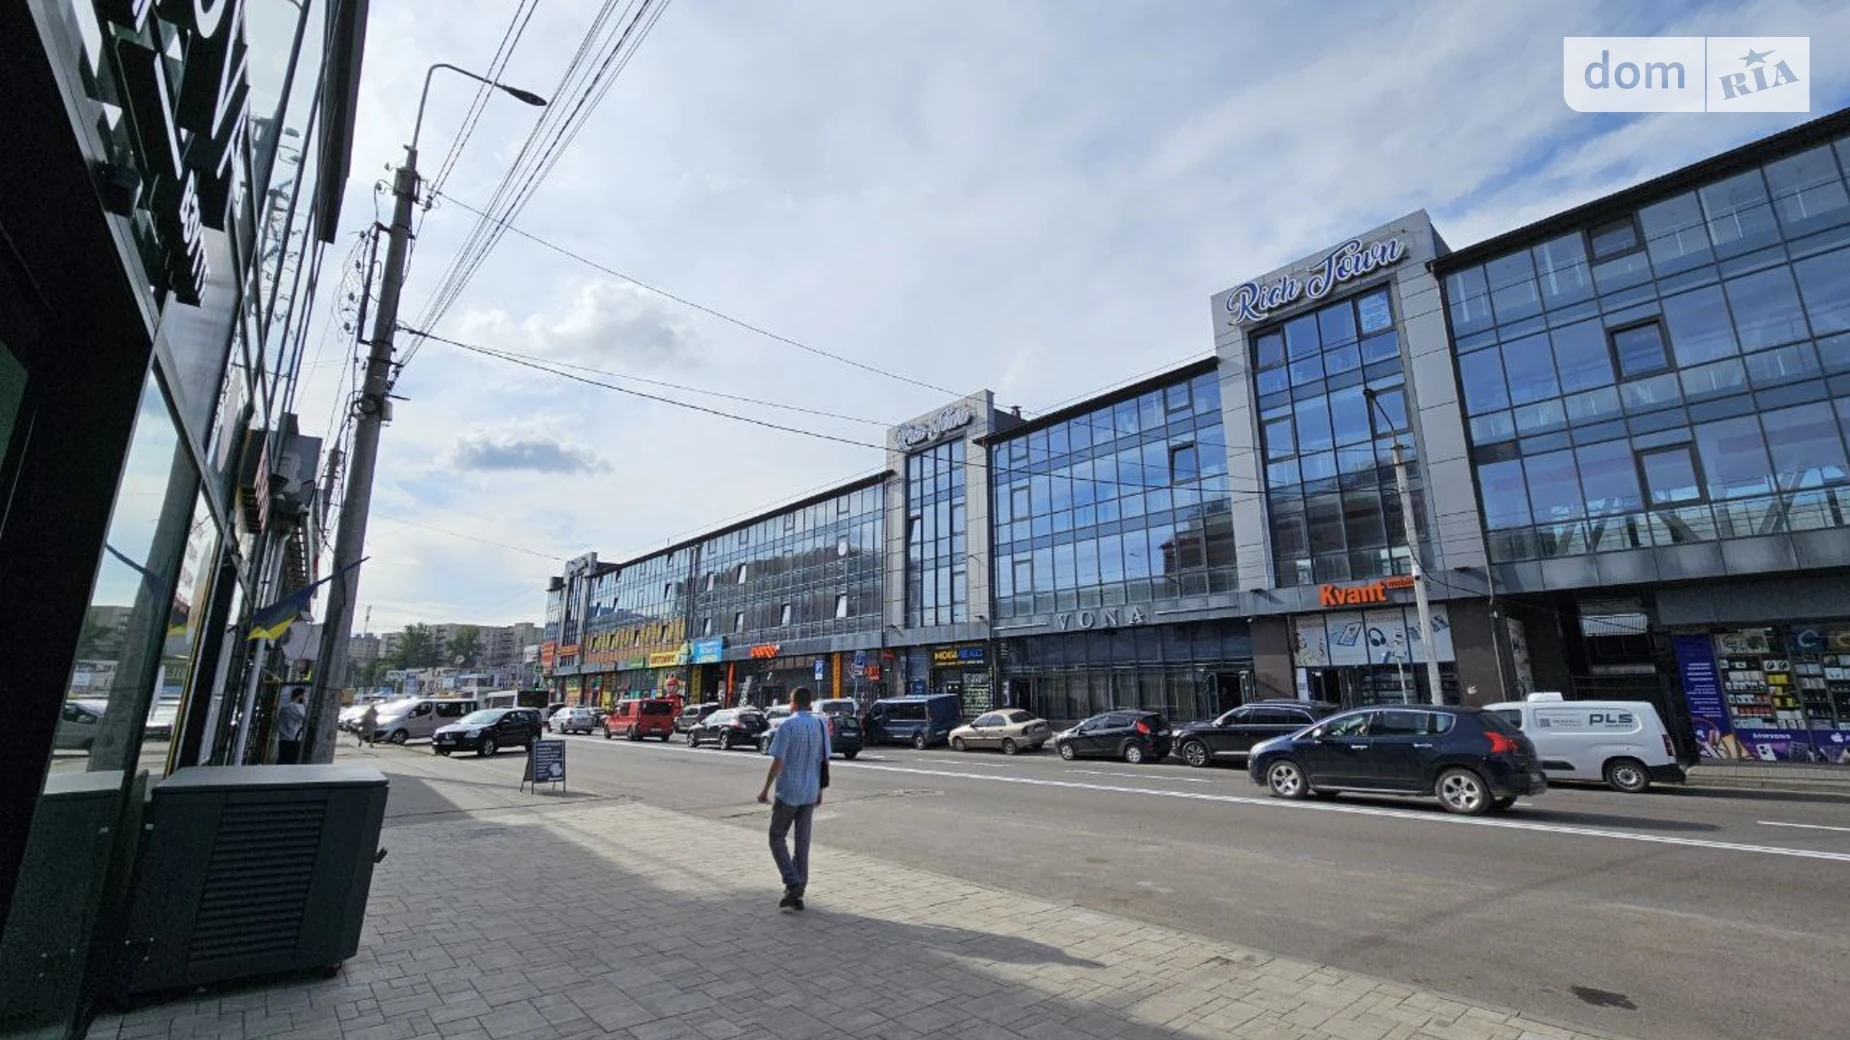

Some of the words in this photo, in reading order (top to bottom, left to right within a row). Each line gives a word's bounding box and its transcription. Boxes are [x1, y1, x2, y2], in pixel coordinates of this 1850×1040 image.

[1226, 275, 1301, 325] Rich
[1306, 237, 1405, 299] Town
[1319, 581, 1387, 606] Kvant
[1056, 605, 1145, 630] VONA
[1588, 714, 1633, 726] PLS
